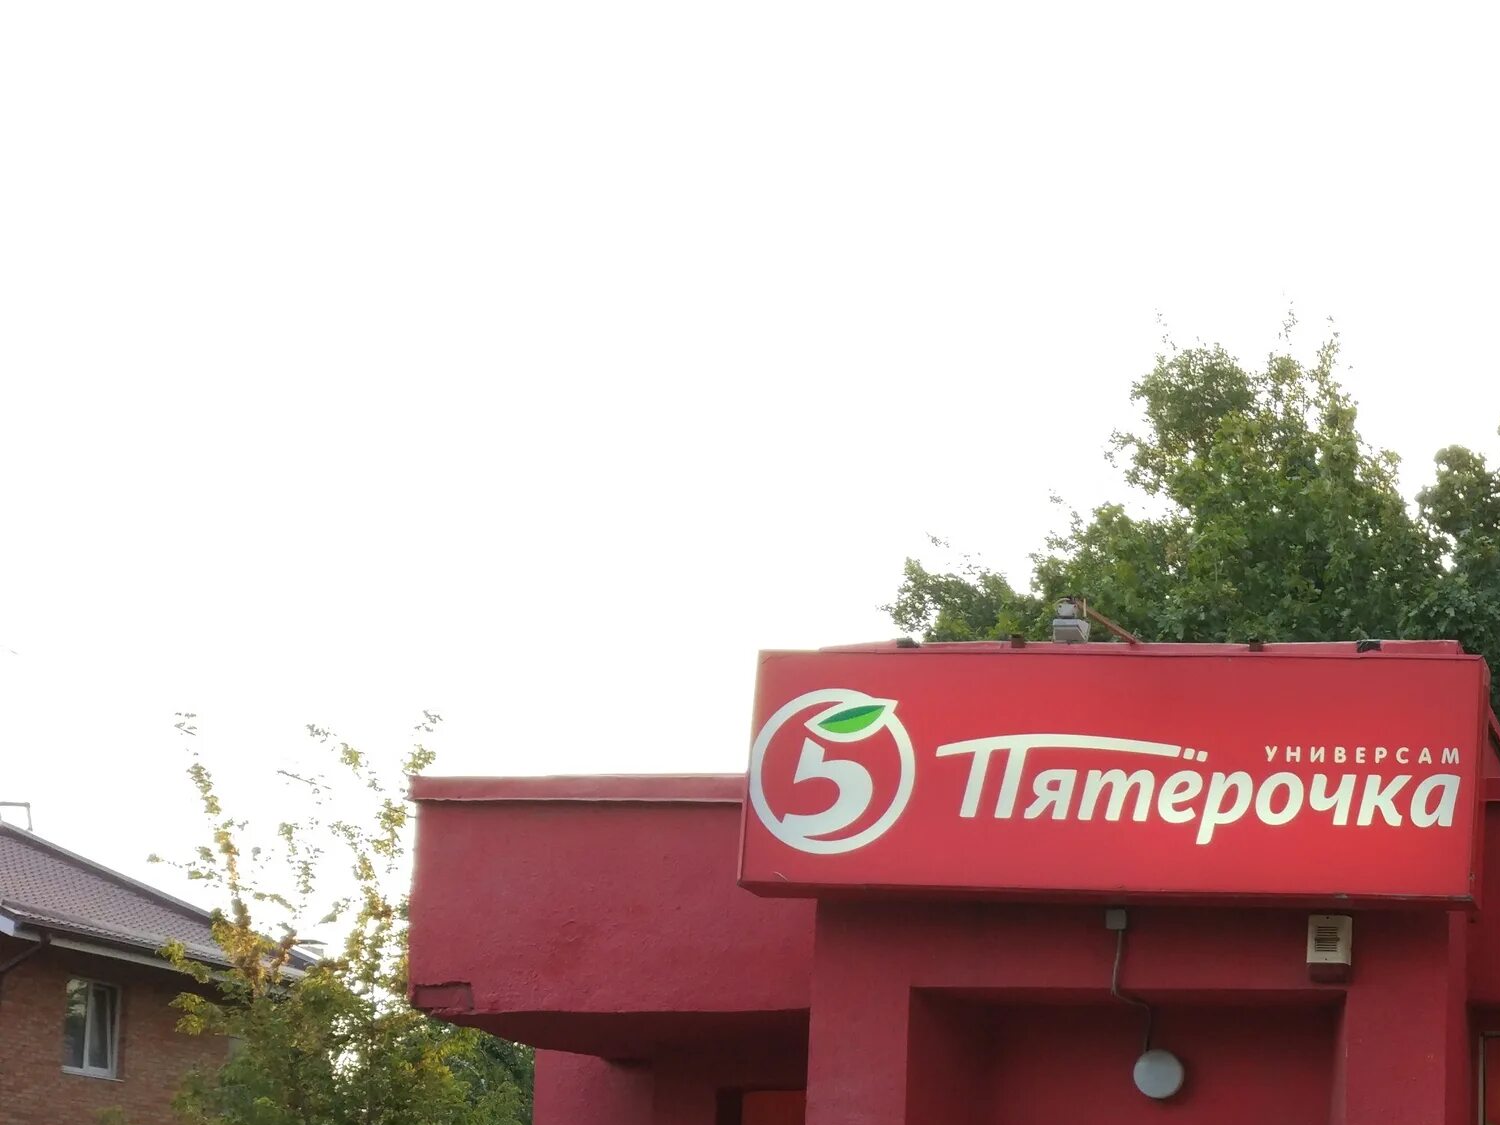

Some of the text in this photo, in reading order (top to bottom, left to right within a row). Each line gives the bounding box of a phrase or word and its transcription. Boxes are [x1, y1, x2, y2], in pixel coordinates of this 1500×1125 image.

[782, 736, 873, 837] 5
[935, 733, 1462, 845] Пятёрочка
[1264, 745, 1461, 765] УНИВЕРСАМ
